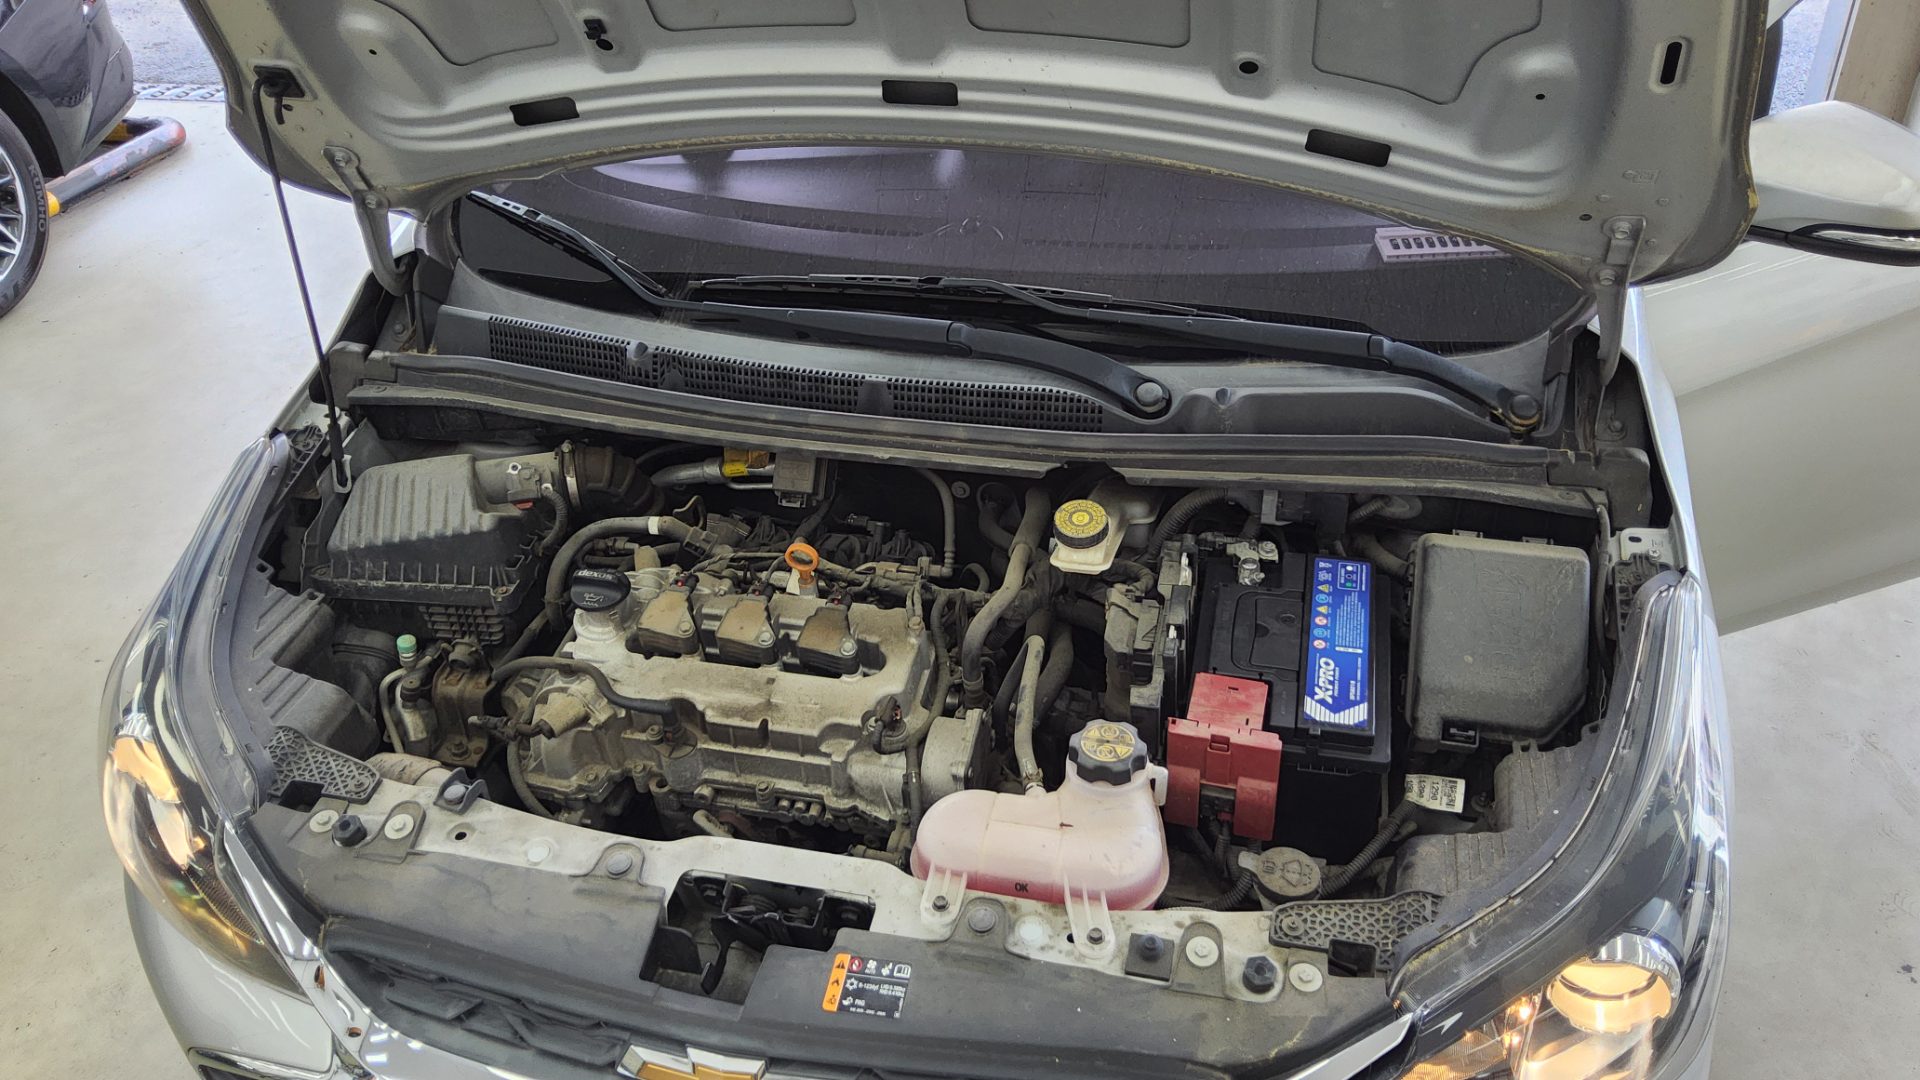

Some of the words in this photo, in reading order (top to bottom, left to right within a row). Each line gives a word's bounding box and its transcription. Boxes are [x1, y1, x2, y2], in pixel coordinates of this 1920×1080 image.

[28, 164, 46, 232] KUMHO
[577, 569, 613, 580] dexos
[1014, 882, 1029, 893] OK
